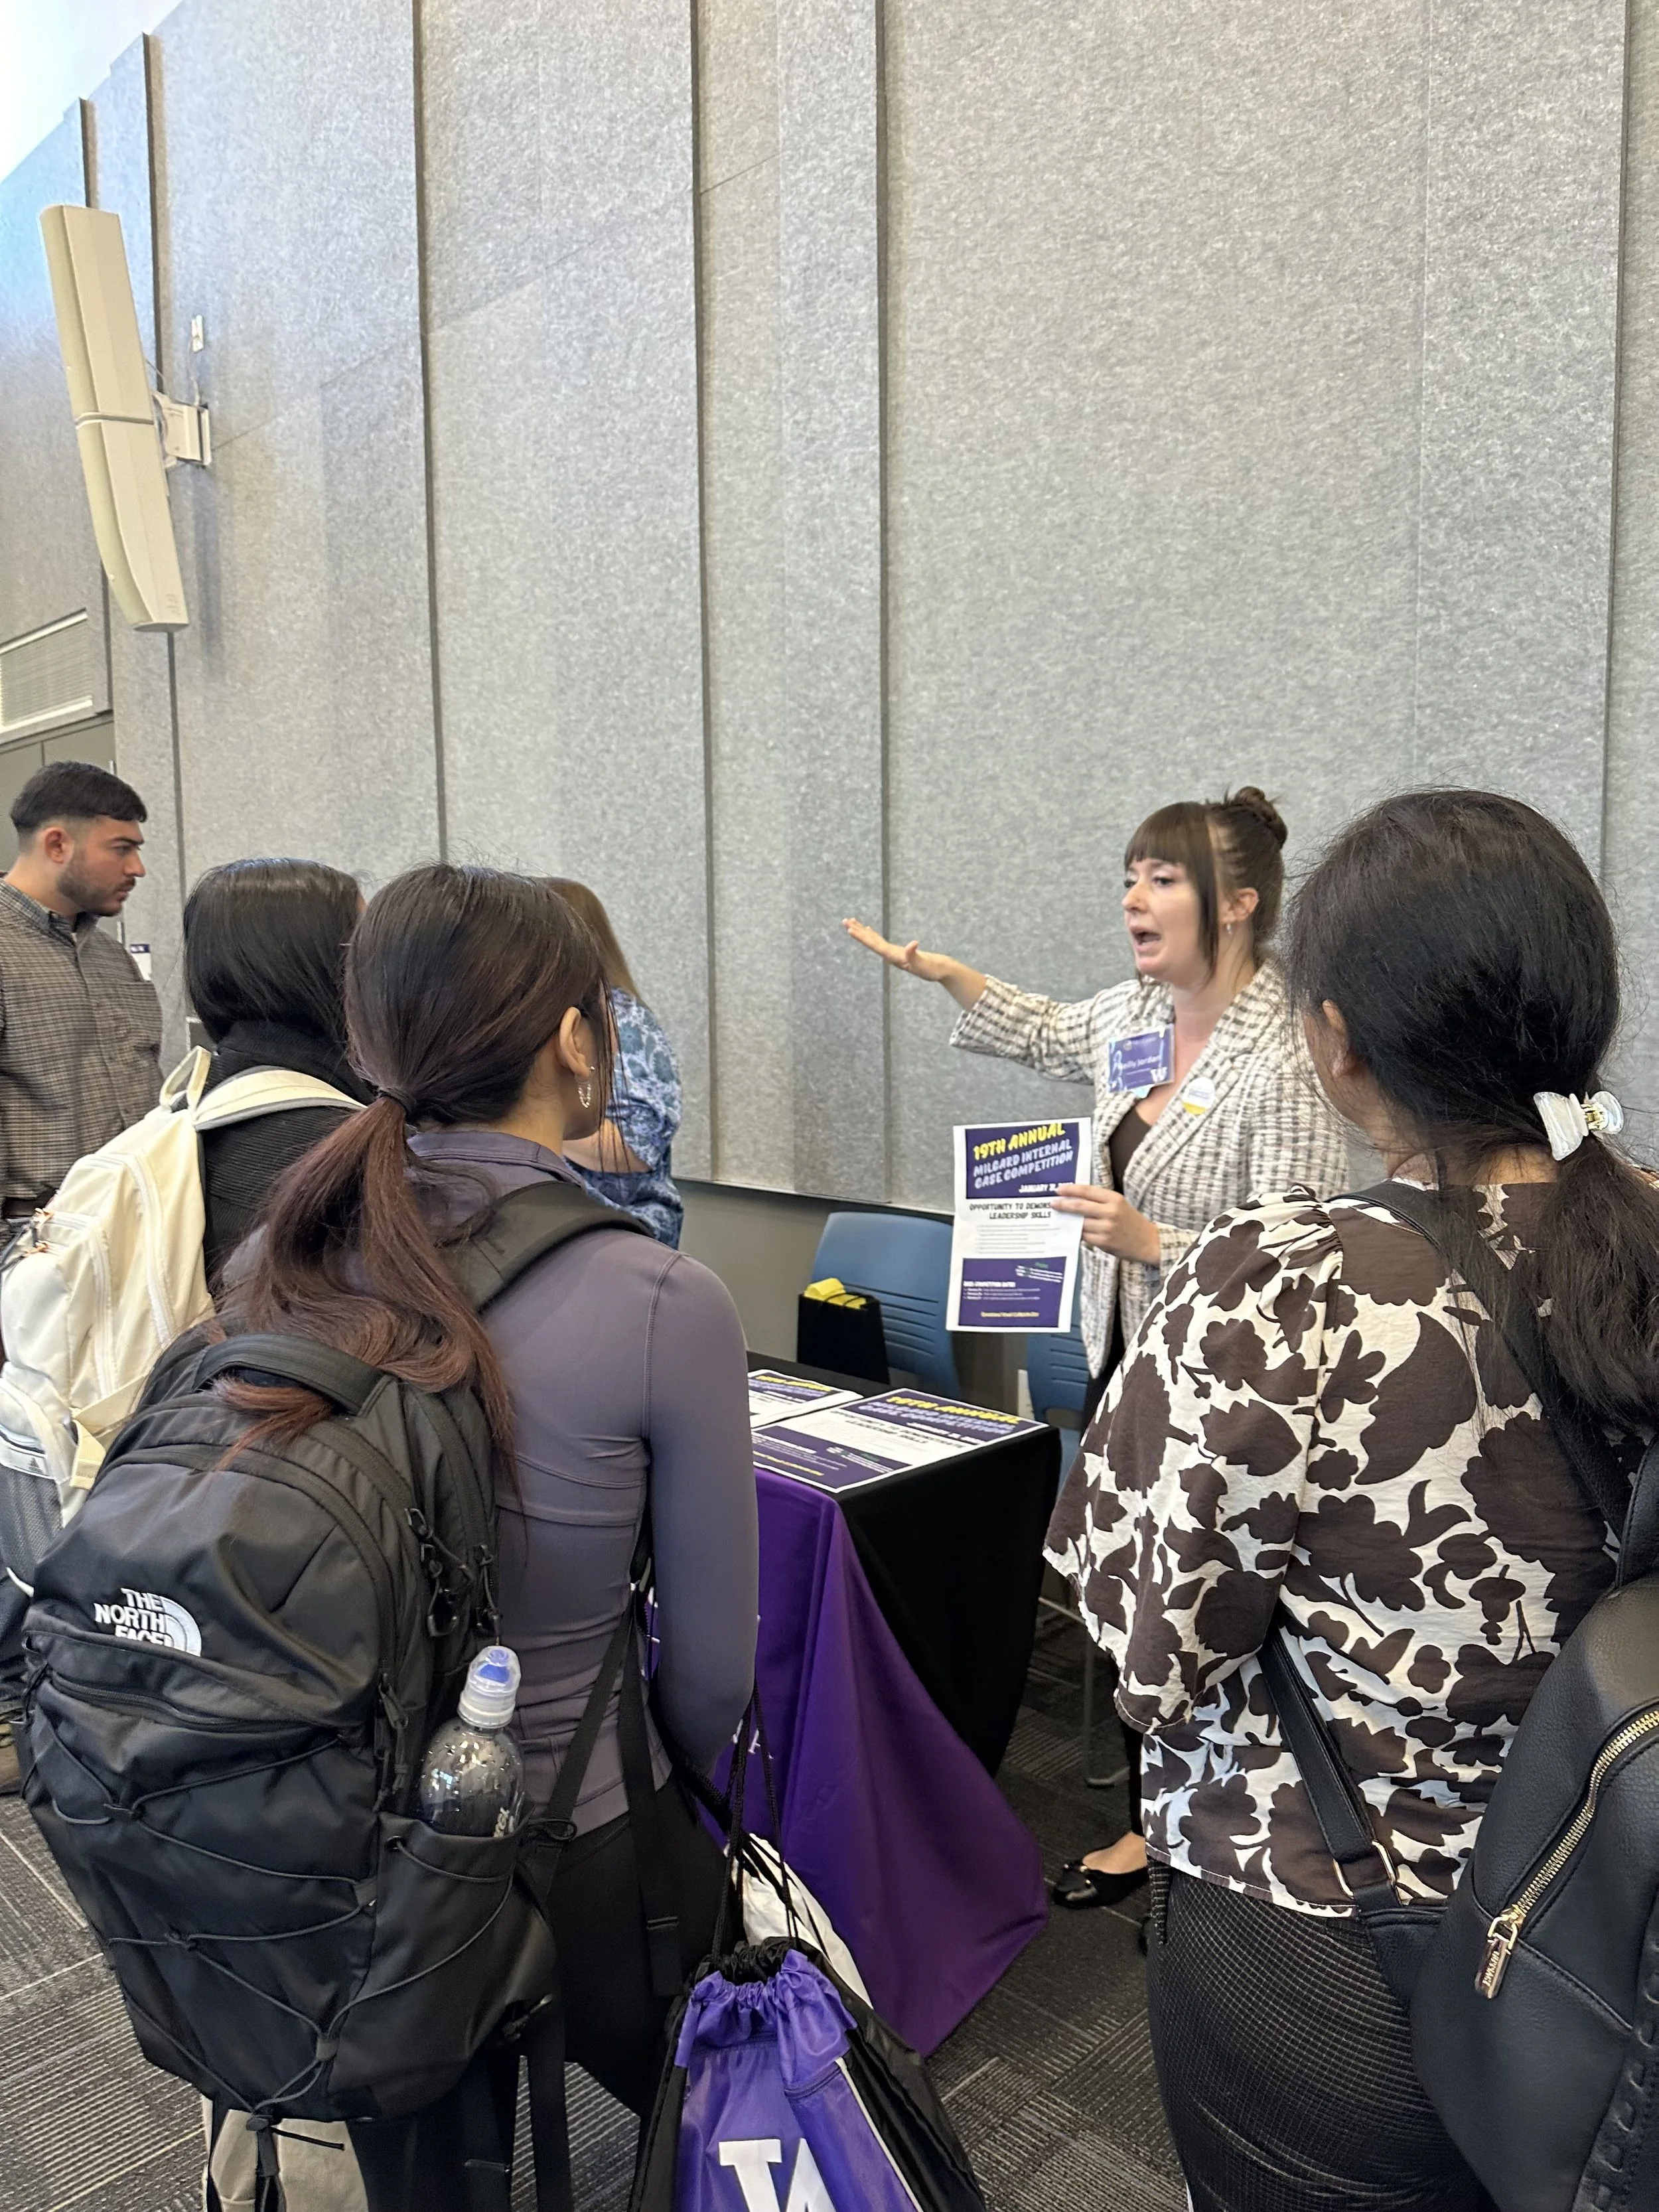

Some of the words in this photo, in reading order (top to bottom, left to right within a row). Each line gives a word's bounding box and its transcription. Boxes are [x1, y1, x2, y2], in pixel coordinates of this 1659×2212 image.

[973, 1138, 1006, 1160] 19TH
[1008, 1123, 1066, 1150] ANNUAL
[974, 1154, 1020, 1177] MILGARD
[1022, 1139, 1072, 1163] INTERNAL
[975, 1171, 1003, 1189] CASE
[1004, 1150, 1073, 1181] COMPETITION
[969, 1203, 1013, 1211] OPPORTUNITY
[120, 1587, 164, 1611] THE
[94, 1603, 166, 1633] NORTH
